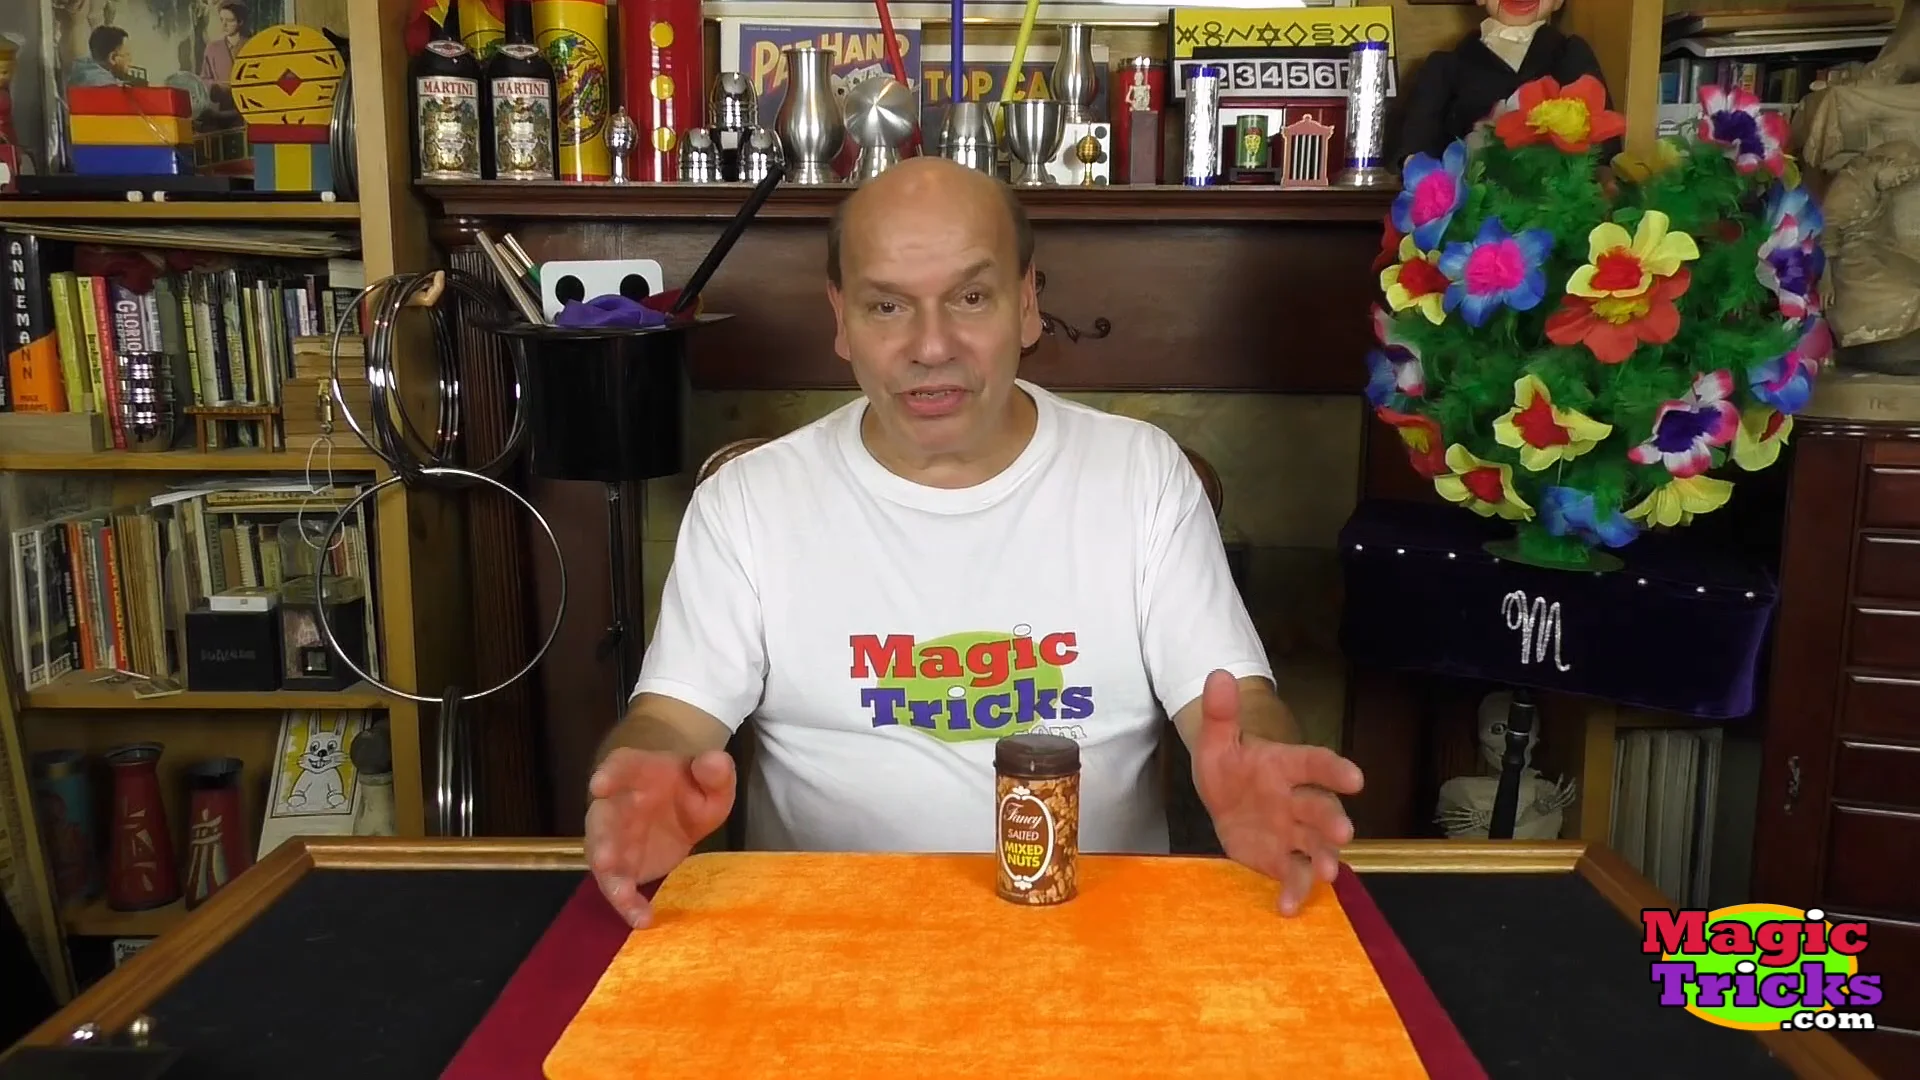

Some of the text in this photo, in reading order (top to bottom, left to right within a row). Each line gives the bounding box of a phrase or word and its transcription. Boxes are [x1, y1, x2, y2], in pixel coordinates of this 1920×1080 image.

[820, 31, 910, 66] HAND
[424, 81, 473, 95] MARTINI
[497, 82, 545, 95] MARTINI
[924, 70, 993, 101] TOP
[11, 241, 33, 380] ANNEMANN
[116, 300, 143, 351] GLORIO
[849, 624, 1079, 688] Magic
[860, 677, 1095, 730] Tricks
[1003, 802, 1043, 829] Fancy
[1005, 840, 1044, 856] MIXED
[1007, 828, 1040, 841] SALTED
[1007, 853, 1041, 868] NUTS
